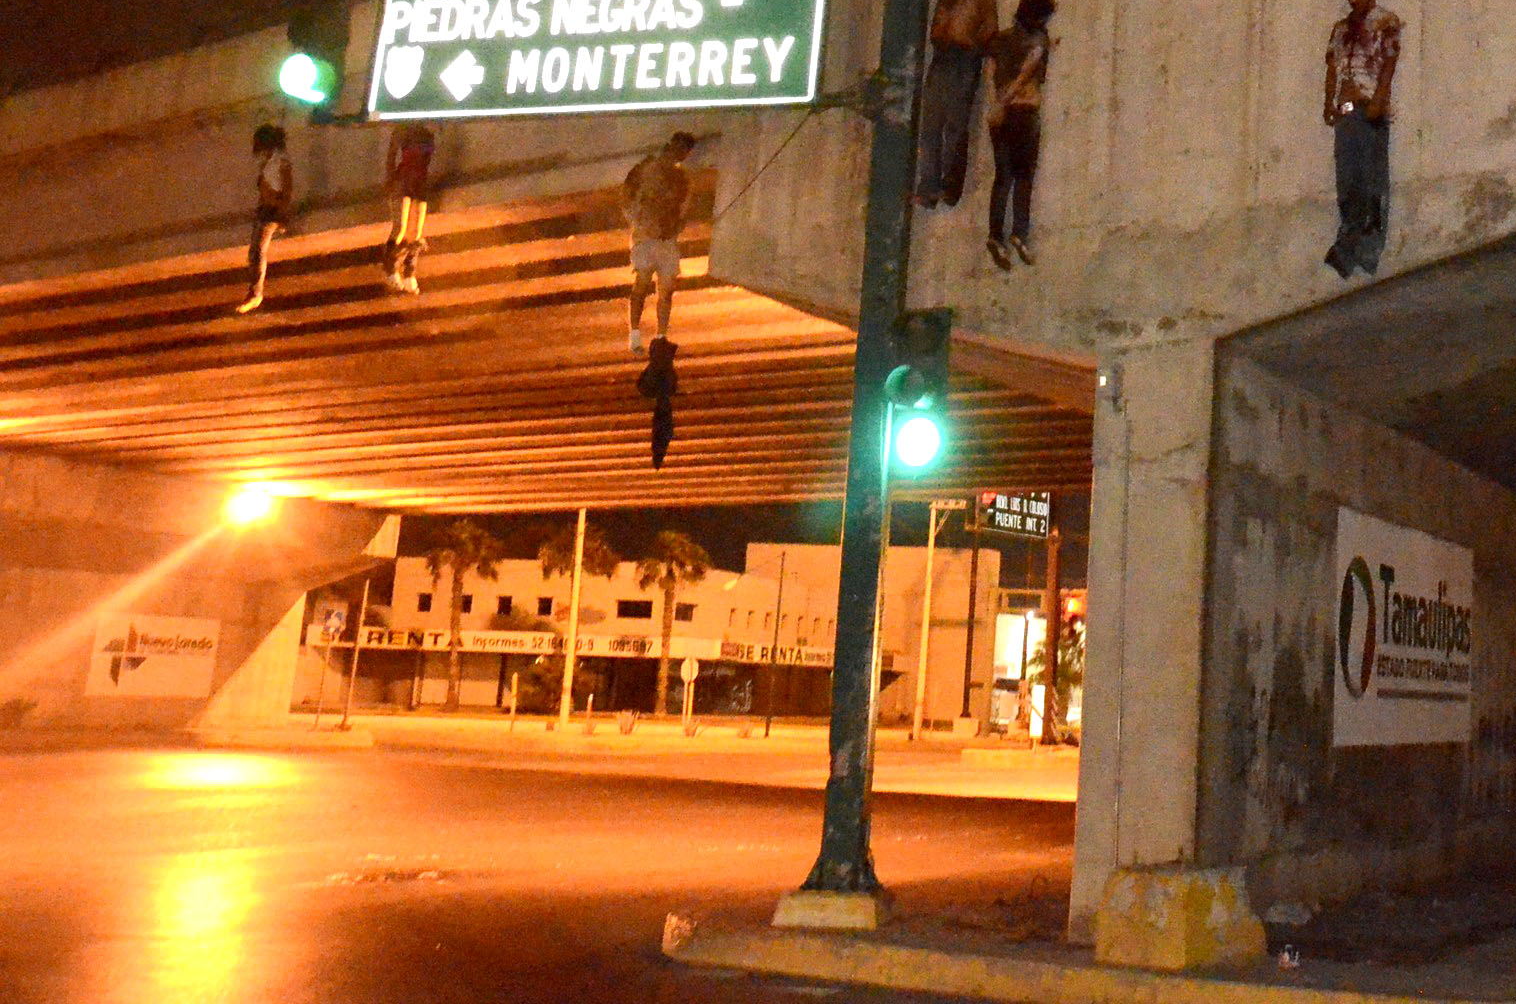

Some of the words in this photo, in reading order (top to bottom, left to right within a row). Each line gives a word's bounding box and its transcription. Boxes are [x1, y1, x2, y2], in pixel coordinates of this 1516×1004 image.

[506, 36, 795, 94] MONTERREY
[995, 511, 1022, 529] PUENTE
[1040, 519, 1046, 533] 2
[1379, 563, 1471, 658] Tamaulipas
[367, 631, 464, 648] RENTA
[761, 646, 803, 665] RENTA
